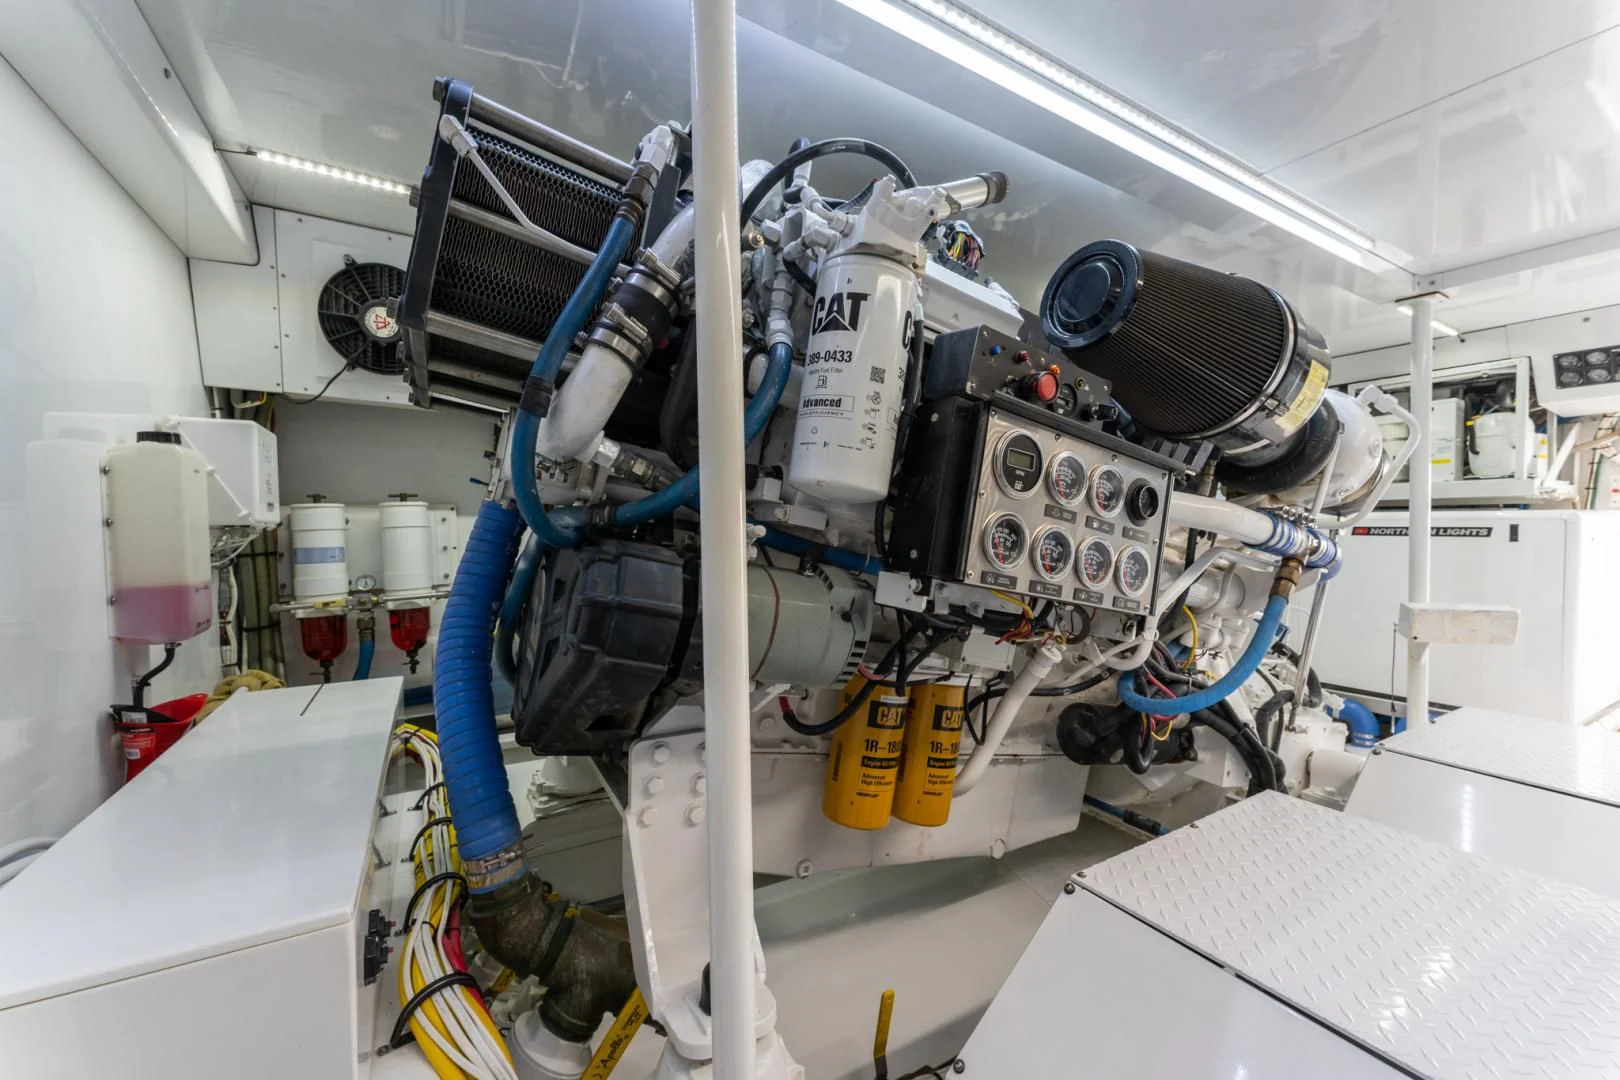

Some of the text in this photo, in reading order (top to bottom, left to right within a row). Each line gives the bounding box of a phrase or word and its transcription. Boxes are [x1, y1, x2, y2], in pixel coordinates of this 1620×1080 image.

[812, 292, 869, 336] CAT
[808, 350, 853, 366] 389-0433
[803, 397, 842, 409] Advanced
[1439, 528, 1489, 536] LIGHTS
[877, 707, 903, 726] CAT
[942, 710, 963, 728] CAT
